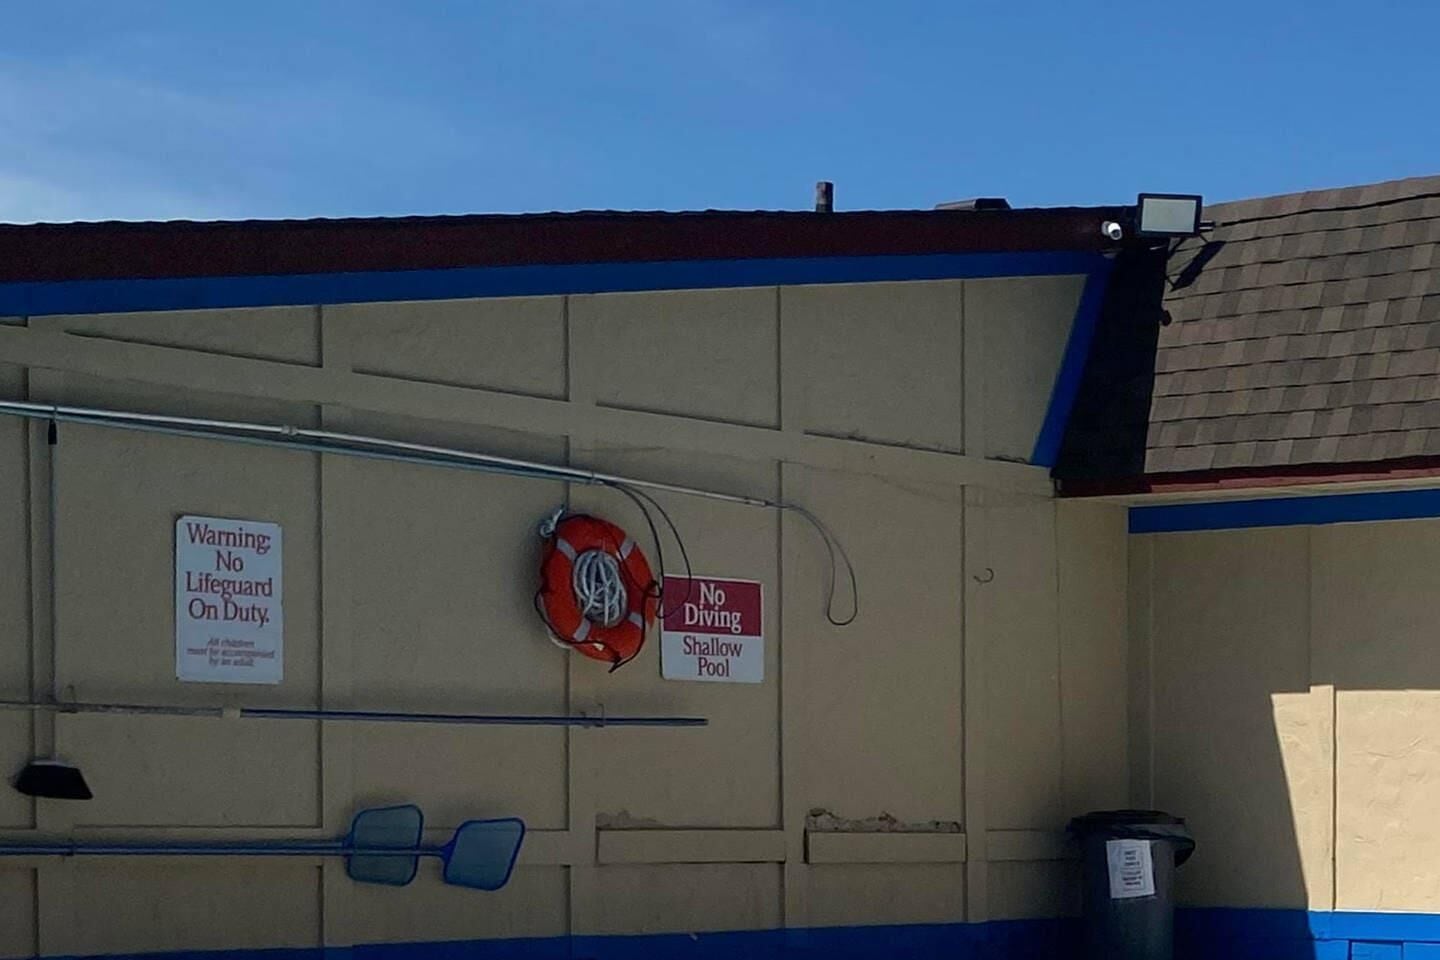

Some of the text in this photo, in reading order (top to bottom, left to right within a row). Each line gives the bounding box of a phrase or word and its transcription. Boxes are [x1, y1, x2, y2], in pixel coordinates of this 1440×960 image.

[216, 550, 243, 572] No
[186, 571, 272, 600] Lifeguard
[699, 582, 725, 605] No
[189, 598, 269, 628] On Duty.
[683, 602, 741, 633] Diving
[683, 635, 743, 657] Shallow
[697, 657, 730, 677] Pool
